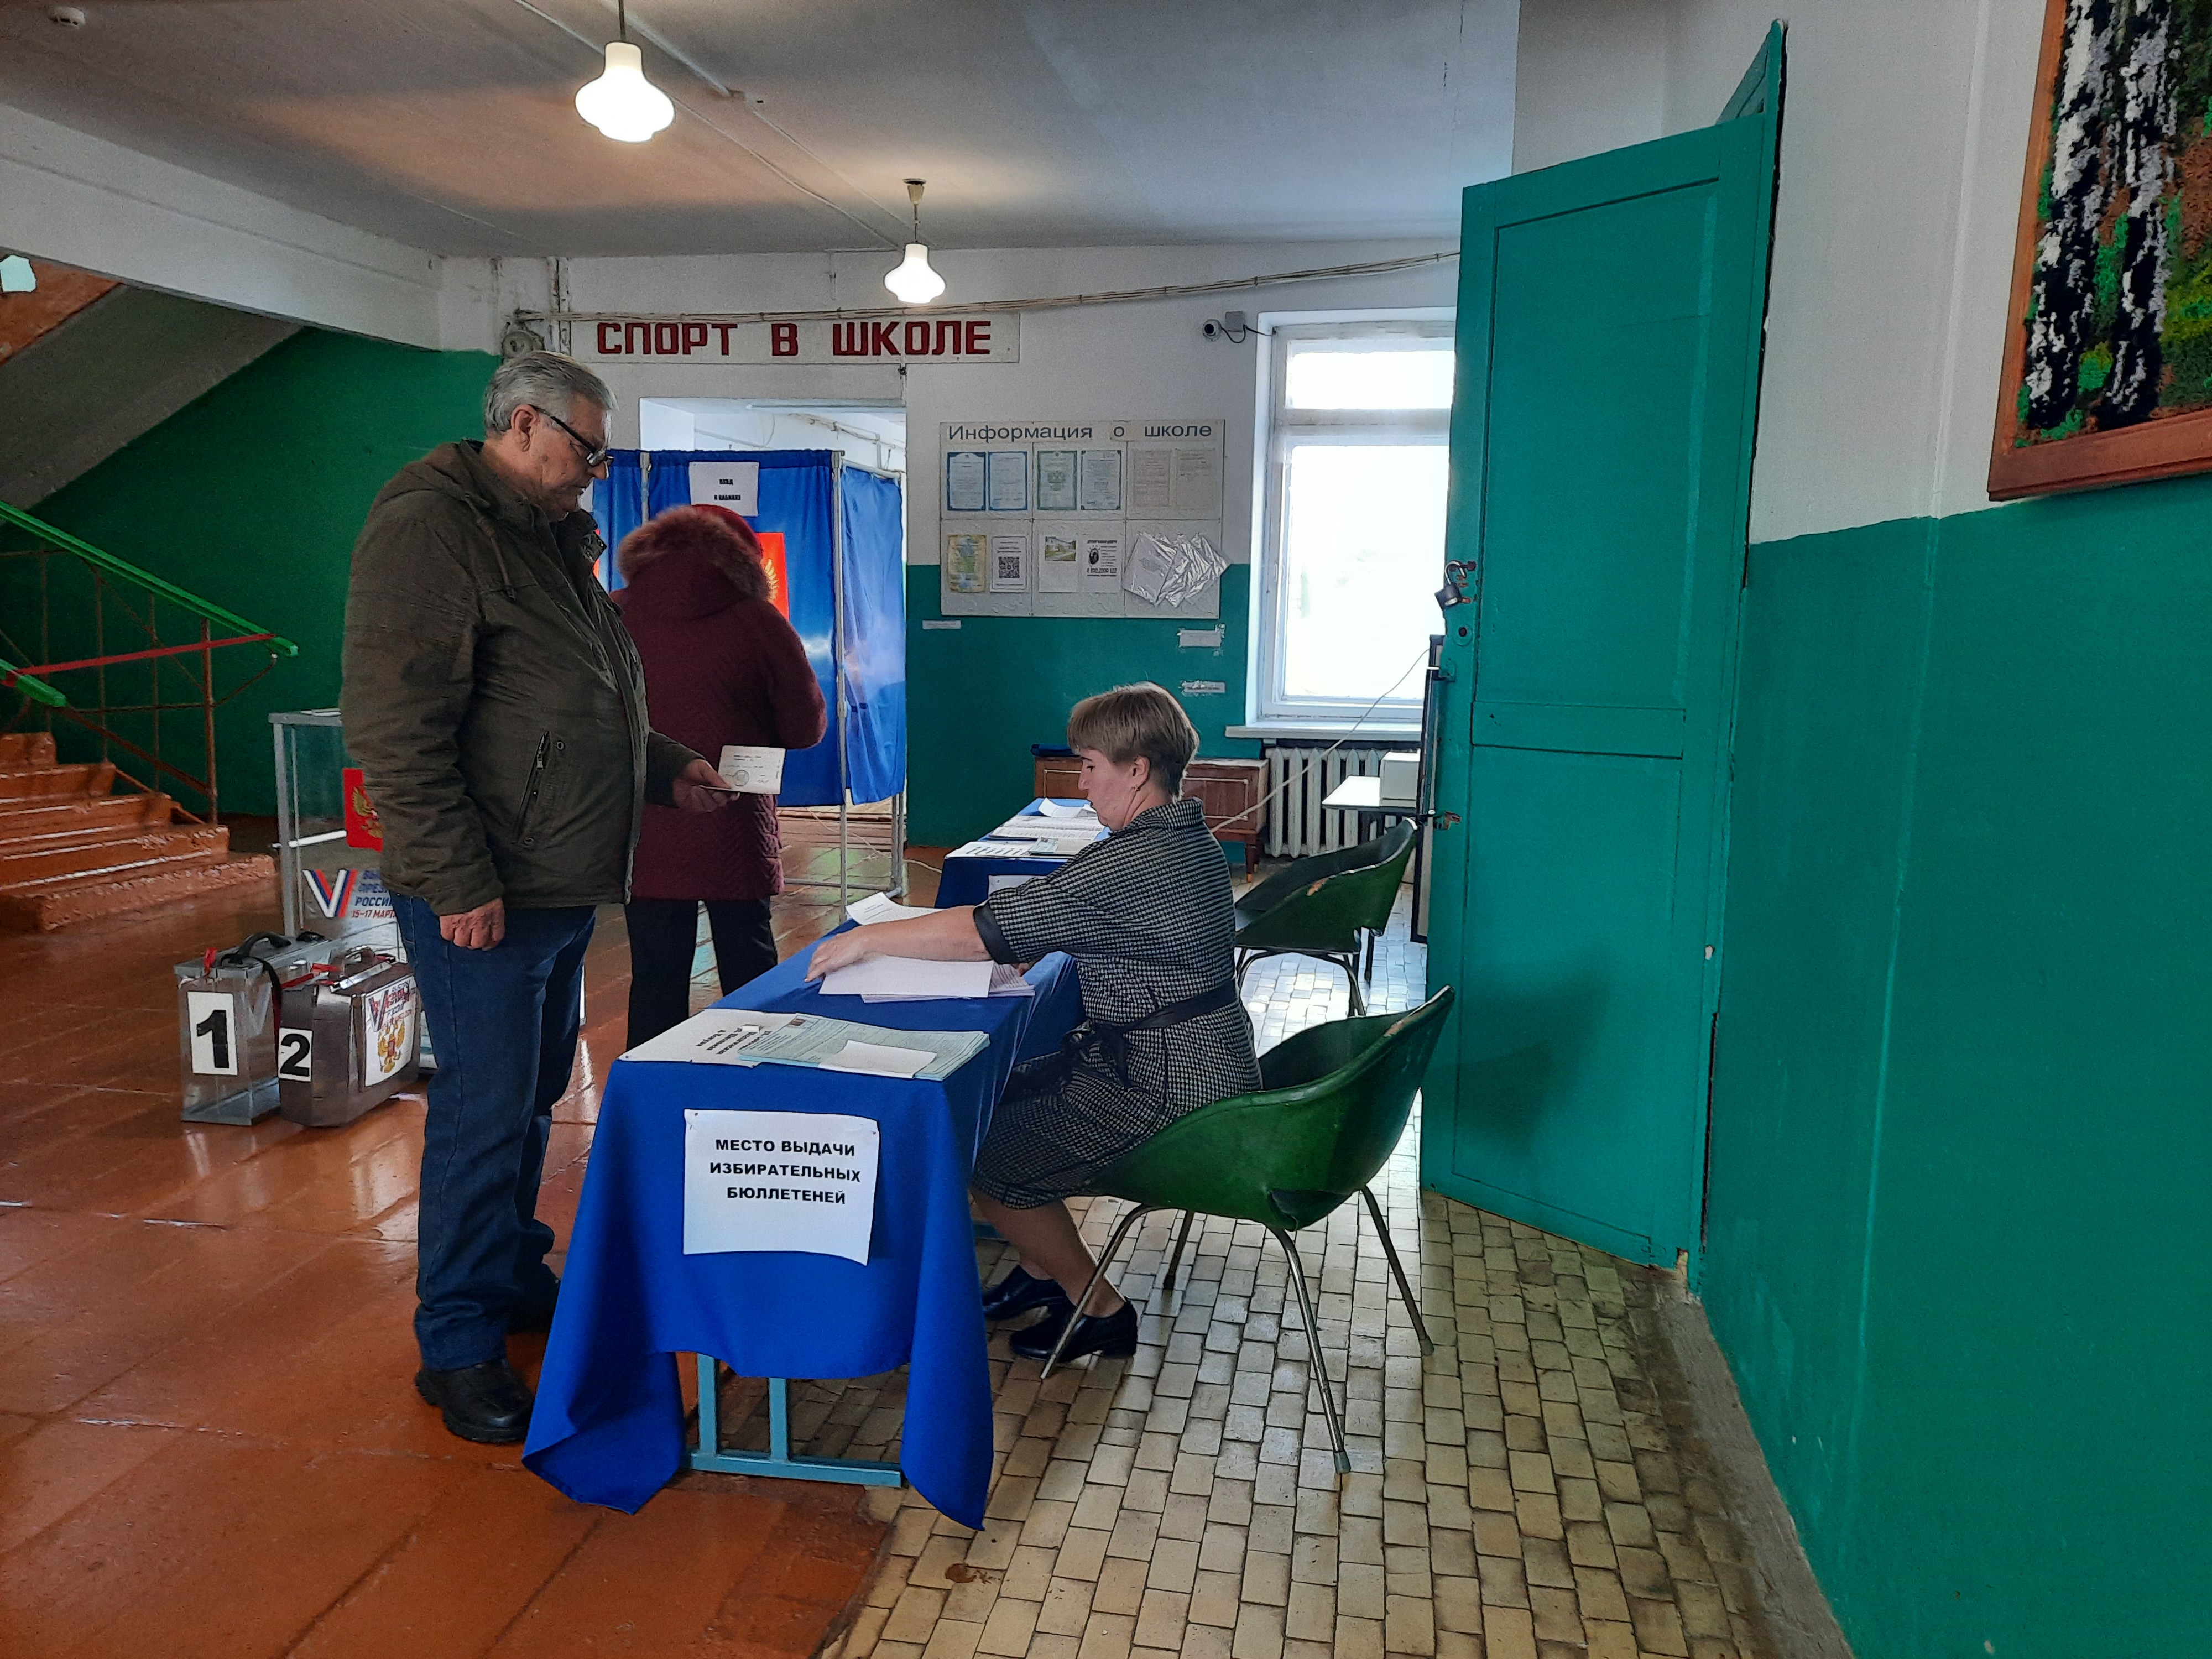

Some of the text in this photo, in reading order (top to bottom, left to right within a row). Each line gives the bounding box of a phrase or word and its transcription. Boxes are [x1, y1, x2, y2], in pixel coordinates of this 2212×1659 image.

[597, 320, 992, 356] СПОРТ В ШКОЛЕ
[948, 424, 1212, 442] Информация о школе
[373, 910, 395, 918] МАРТ
[196, 1009, 230, 1069] 1
[279, 1033, 310, 1077] 2
[715, 1139, 855, 1157] МЕСТО ВЫДАЧИ
[709, 1162, 862, 1182] ИЗБИРАТЕЛЬНЫХ
[727, 1187, 846, 1205] БЮЛЛЕТЕНЕЙ
